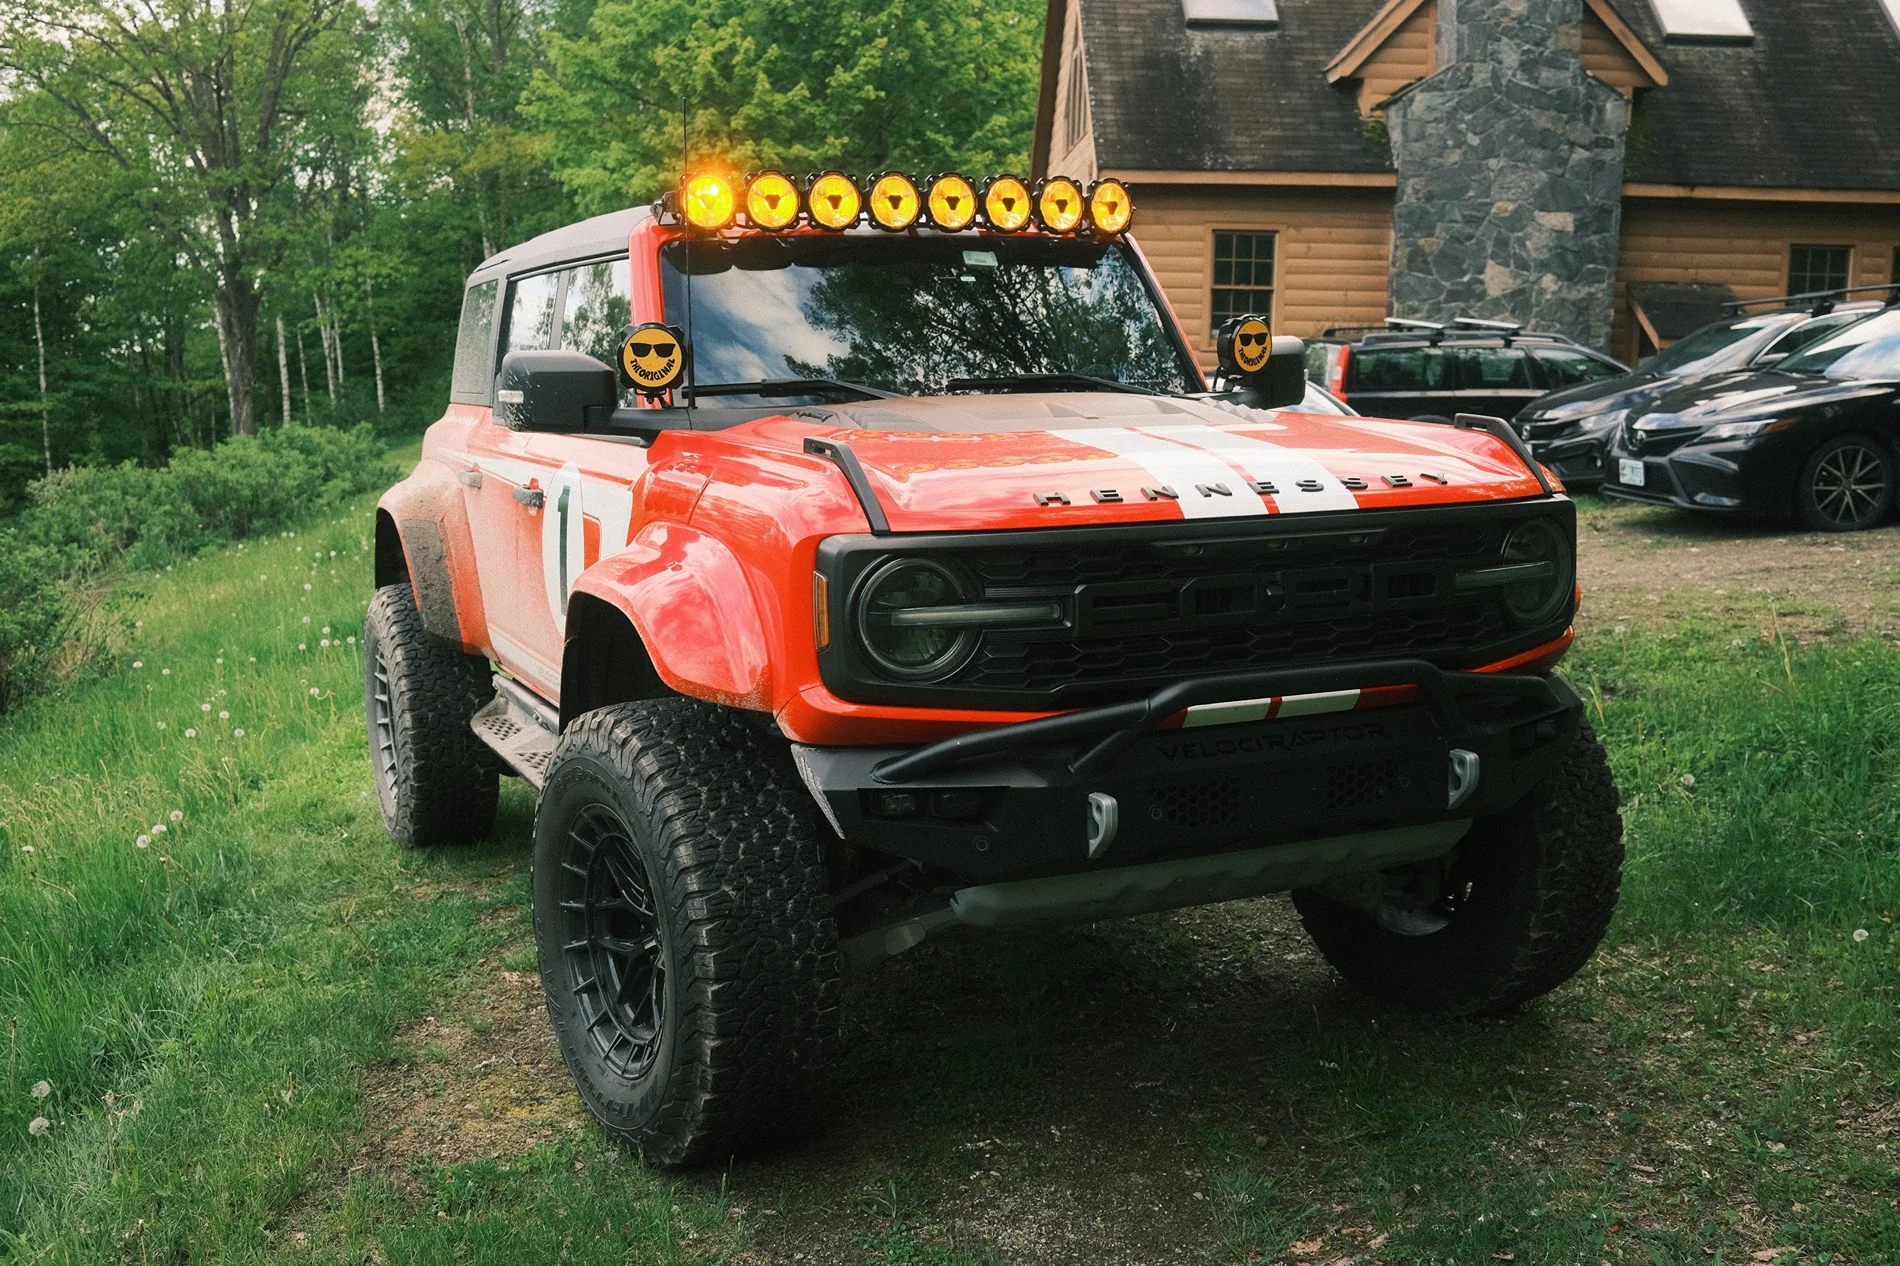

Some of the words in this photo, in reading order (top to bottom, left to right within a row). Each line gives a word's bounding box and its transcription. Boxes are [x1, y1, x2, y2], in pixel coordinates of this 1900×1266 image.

[639, 358, 676, 381] ORIGINAL
[1032, 472, 1448, 506] HENNESSEY
[1157, 721, 1387, 763] VELOCIRAPTOR
